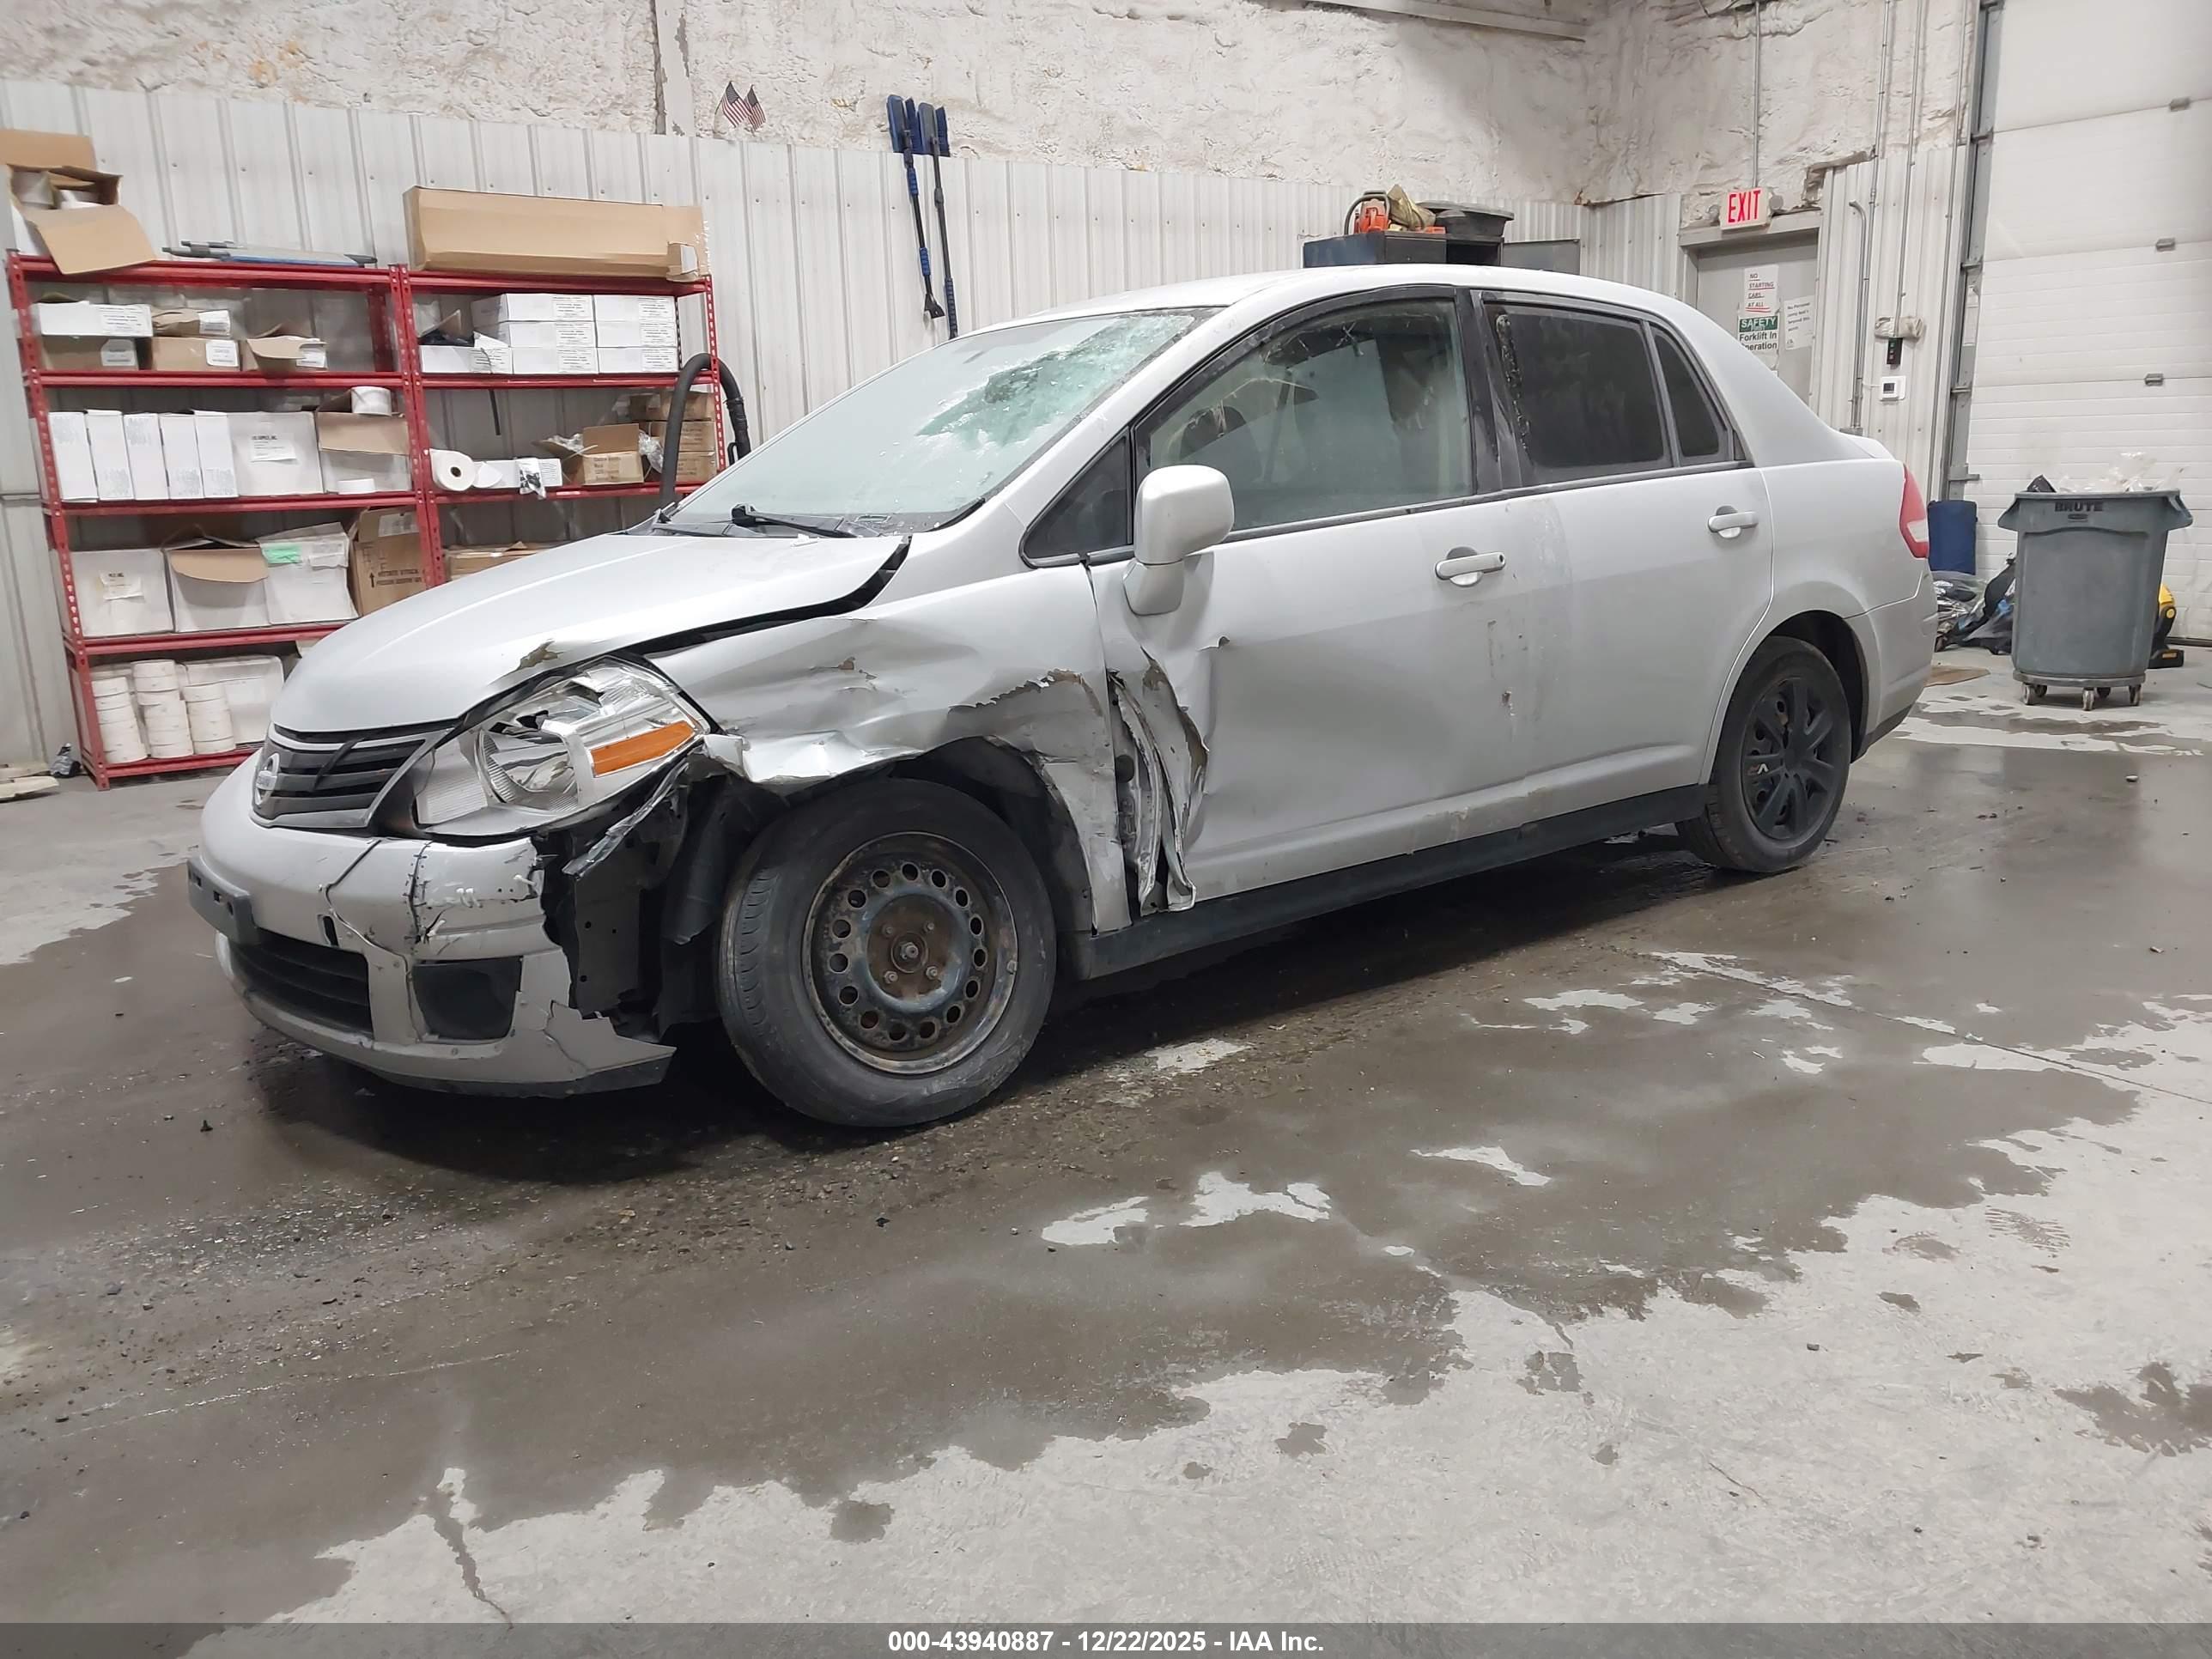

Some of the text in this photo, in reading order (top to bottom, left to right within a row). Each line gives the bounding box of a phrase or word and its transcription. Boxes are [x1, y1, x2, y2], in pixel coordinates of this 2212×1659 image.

[1728, 190, 1761, 223] EXIT
[1741, 317, 1776, 328] SAFETY
[1739, 331, 1767, 342] Forklift
[1742, 342, 1778, 350] eration
[2055, 501, 2103, 512] BRUTE
